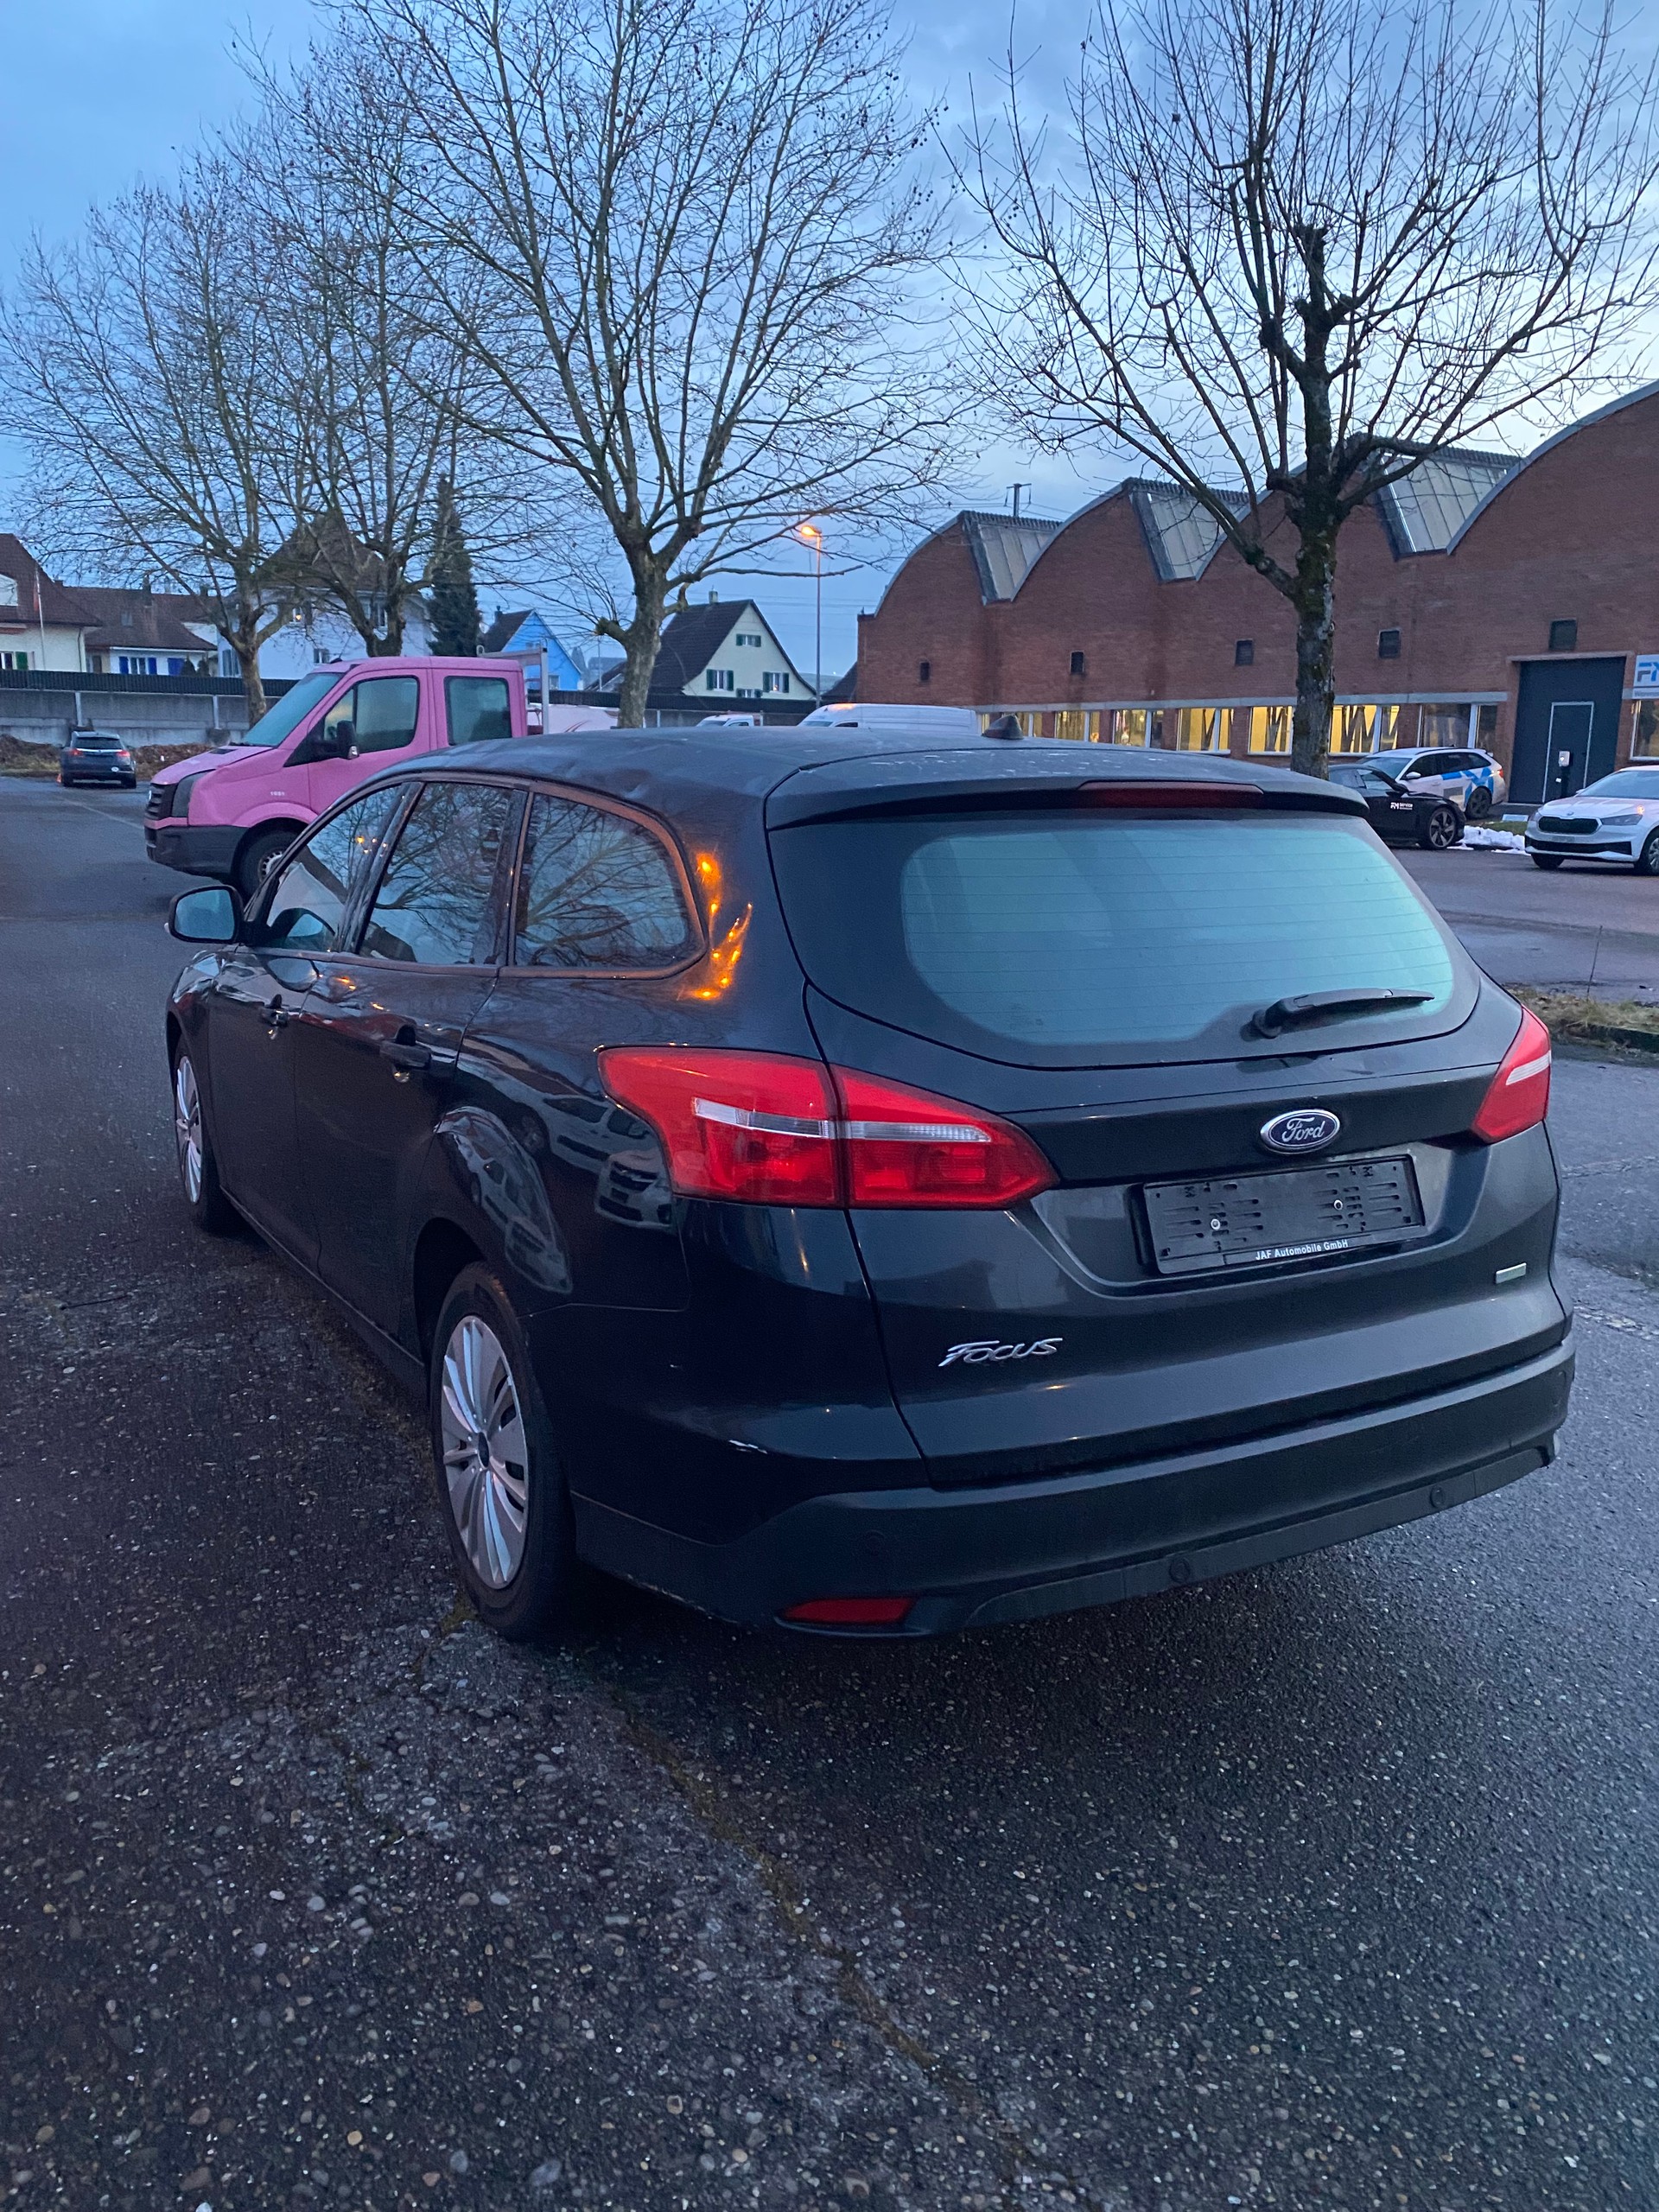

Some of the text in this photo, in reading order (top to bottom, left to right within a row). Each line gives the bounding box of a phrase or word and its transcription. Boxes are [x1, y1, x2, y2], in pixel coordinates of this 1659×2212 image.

[1281, 1116, 1325, 1142] Ford
[1255, 1239, 1348, 1261] JAF Automobile GmbH
